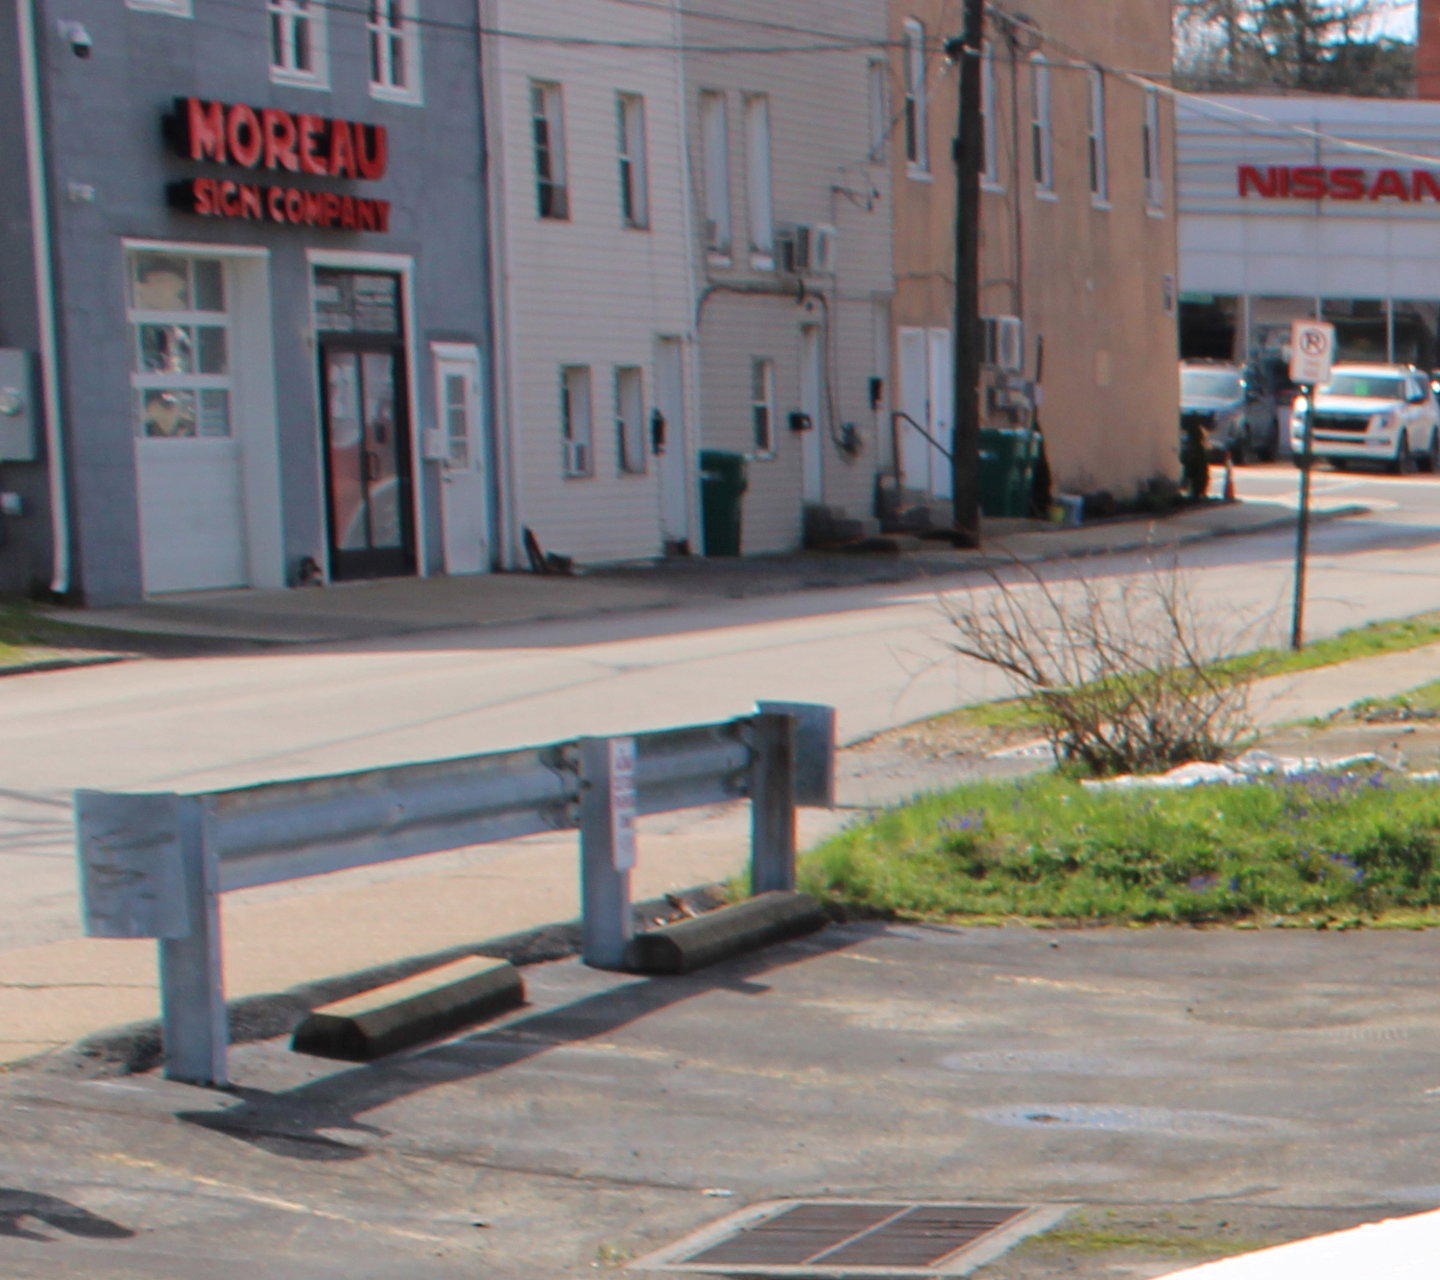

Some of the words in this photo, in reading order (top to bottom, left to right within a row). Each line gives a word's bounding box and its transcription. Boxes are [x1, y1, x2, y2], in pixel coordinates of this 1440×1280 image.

[186, 96, 388, 180] MOREAU
[192, 177, 263, 220] SIGN
[267, 185, 391, 233] COMPANY
